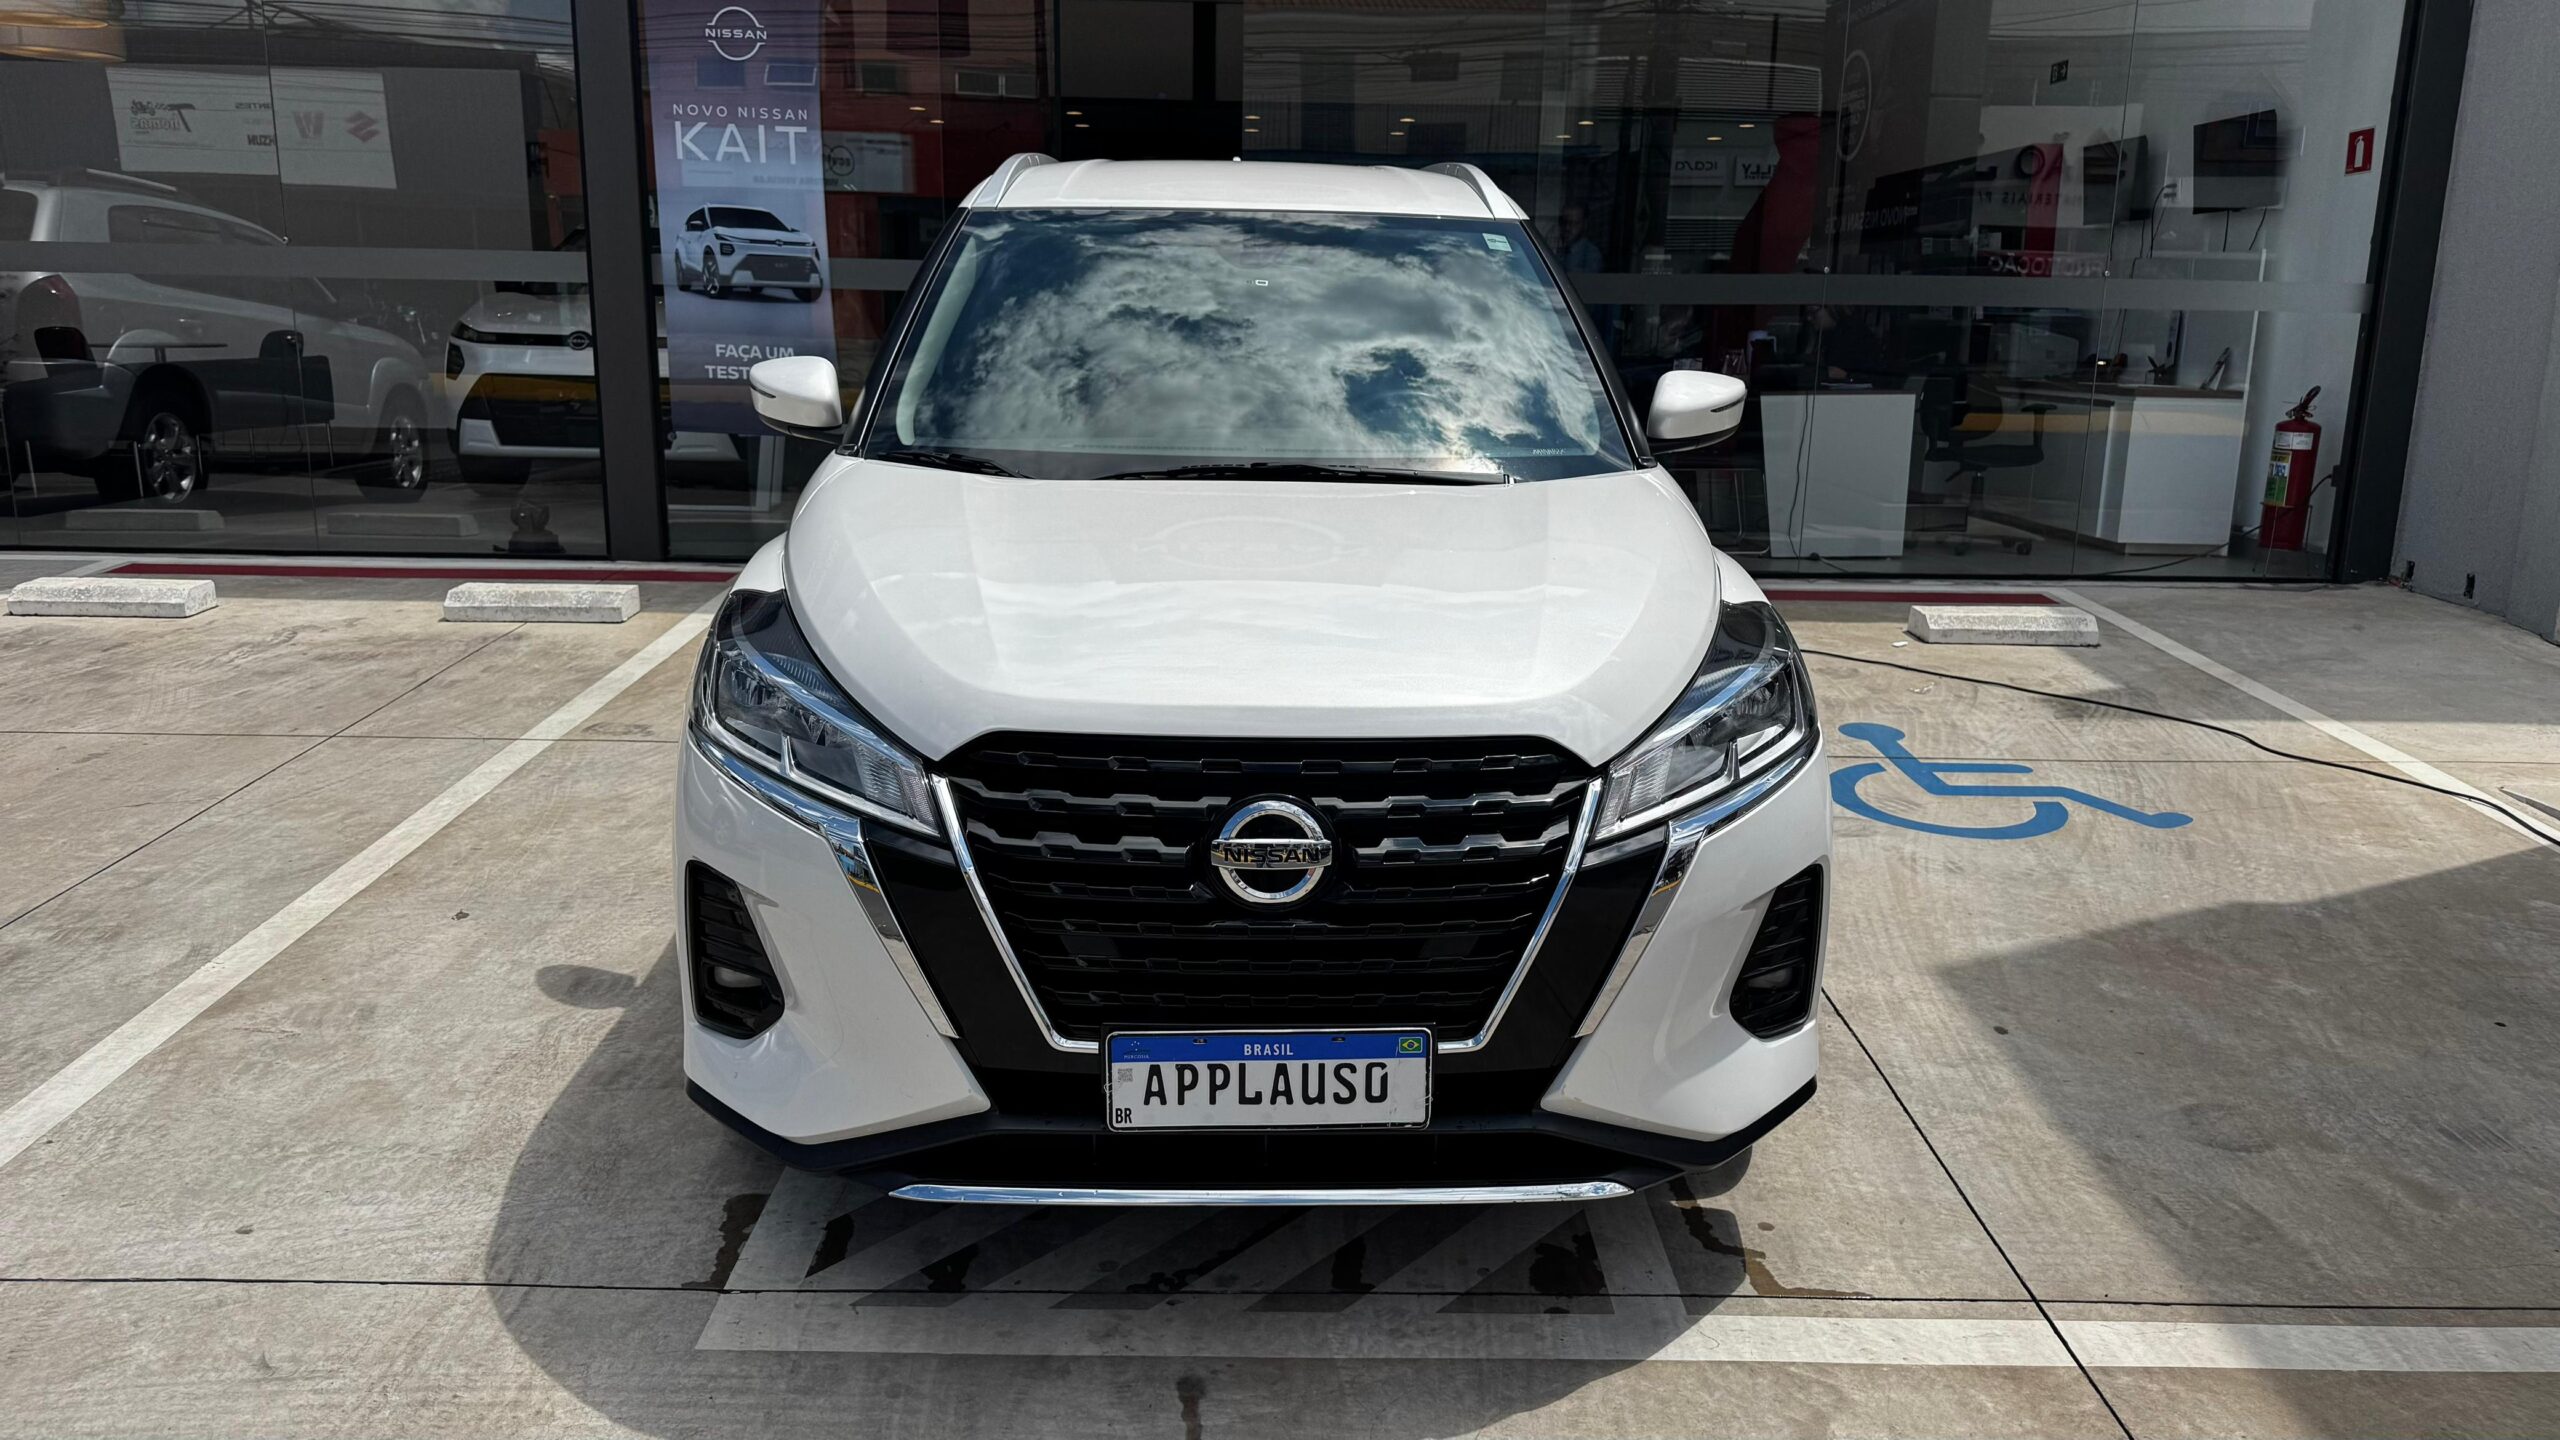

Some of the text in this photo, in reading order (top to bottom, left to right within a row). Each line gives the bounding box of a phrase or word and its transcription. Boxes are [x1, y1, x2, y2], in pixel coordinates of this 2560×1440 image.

[705, 28, 767, 39] NISSAN
[673, 104, 808, 120] NOVO NISSAN
[675, 121, 808, 165] KAIT
[716, 344, 792, 361] FAÇA UM
[1224, 846, 1320, 863] NISSAN
[1243, 1043, 1294, 1056] BRASIL
[1143, 1062, 1389, 1106] APPLAUSO
[1115, 1107, 1133, 1124] BR
